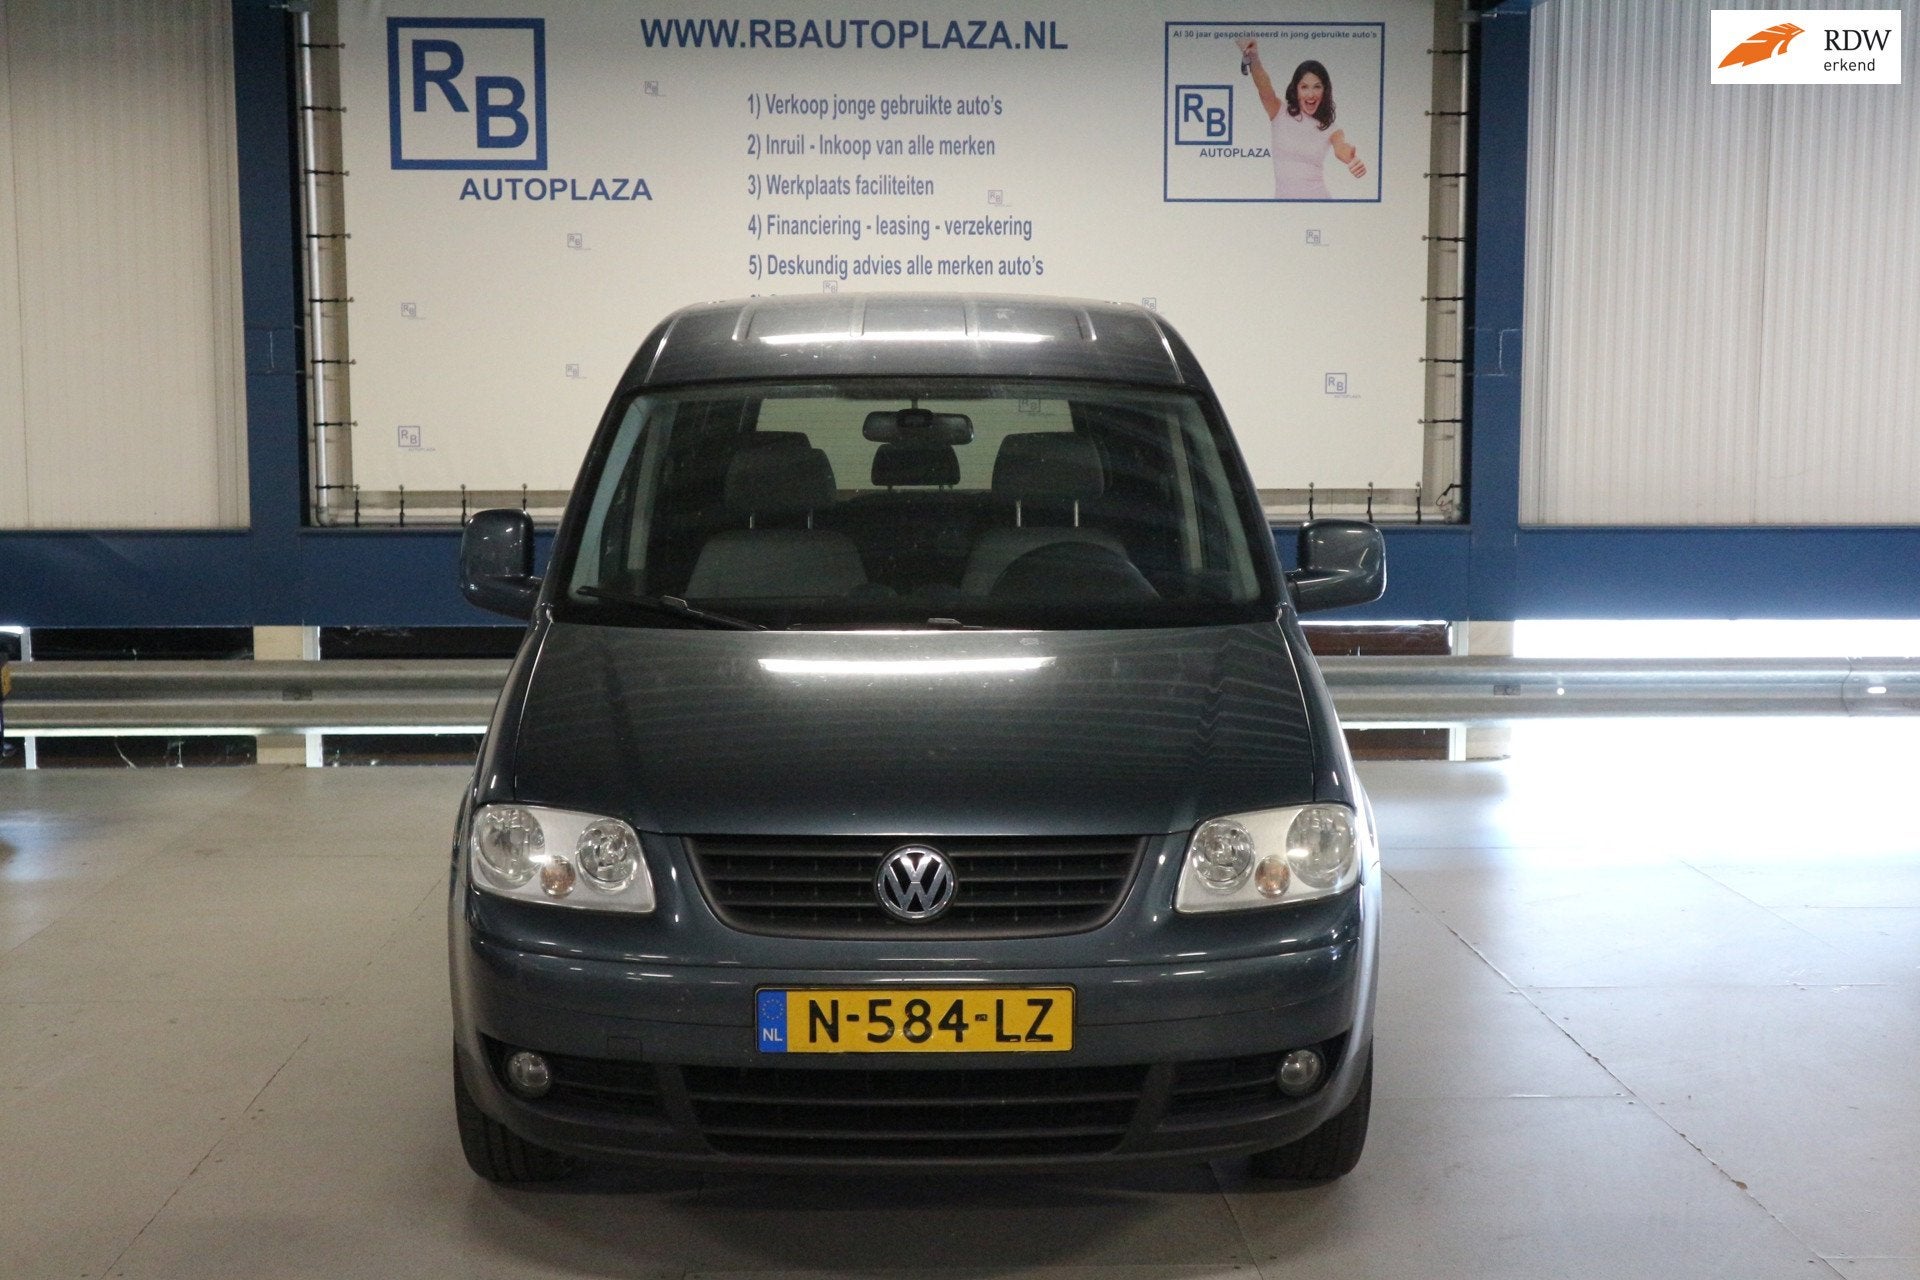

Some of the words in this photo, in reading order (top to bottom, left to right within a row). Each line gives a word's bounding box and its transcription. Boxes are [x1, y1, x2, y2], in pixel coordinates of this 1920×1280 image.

[640, 18, 1069, 50] WWW.RBAUTOPLAZA.NL
[1184, 30, 1195, 38] 30
[1196, 30, 1212, 40] jaar
[1214, 30, 1279, 40] gespecialiseerd
[1280, 30, 1289, 38] in
[1290, 30, 1310, 40] jong
[1311, 30, 1350, 40] gebruikte
[1352, 30, 1378, 39] auto's
[747, 94, 761, 120] 1)
[766, 94, 829, 120] Verkoop
[833, 94, 876, 121] jonge
[880, 94, 952, 120] gebruikte
[747, 134, 762, 160] 2)
[766, 134, 805, 155] Inruil
[819, 134, 872, 161] Inkoop
[876, 139, 903, 156] van
[907, 134, 935, 156] alle
[939, 134, 996, 156] merken
[1199, 148, 1271, 158] AUTOPLAZA
[459, 178, 654, 202] AUTOPLAZA
[748, 174, 762, 200] 3)
[766, 174, 851, 201] Werkplaats
[855, 174, 934, 196] faciliteiten
[748, 214, 762, 241] 4)
[766, 214, 861, 241] Financiering
[876, 214, 930, 241] leasing
[944, 214, 1033, 242] verzekering
[748, 254, 763, 281] 5)
[767, 254, 848, 281] Deskundig
[853, 254, 902, 276] advies
[906, 254, 933, 276] alle
[938, 254, 994, 276] merken
[808, 998, 1054, 1043] N-584-LZ
[762, 1028, 783, 1042] NL
